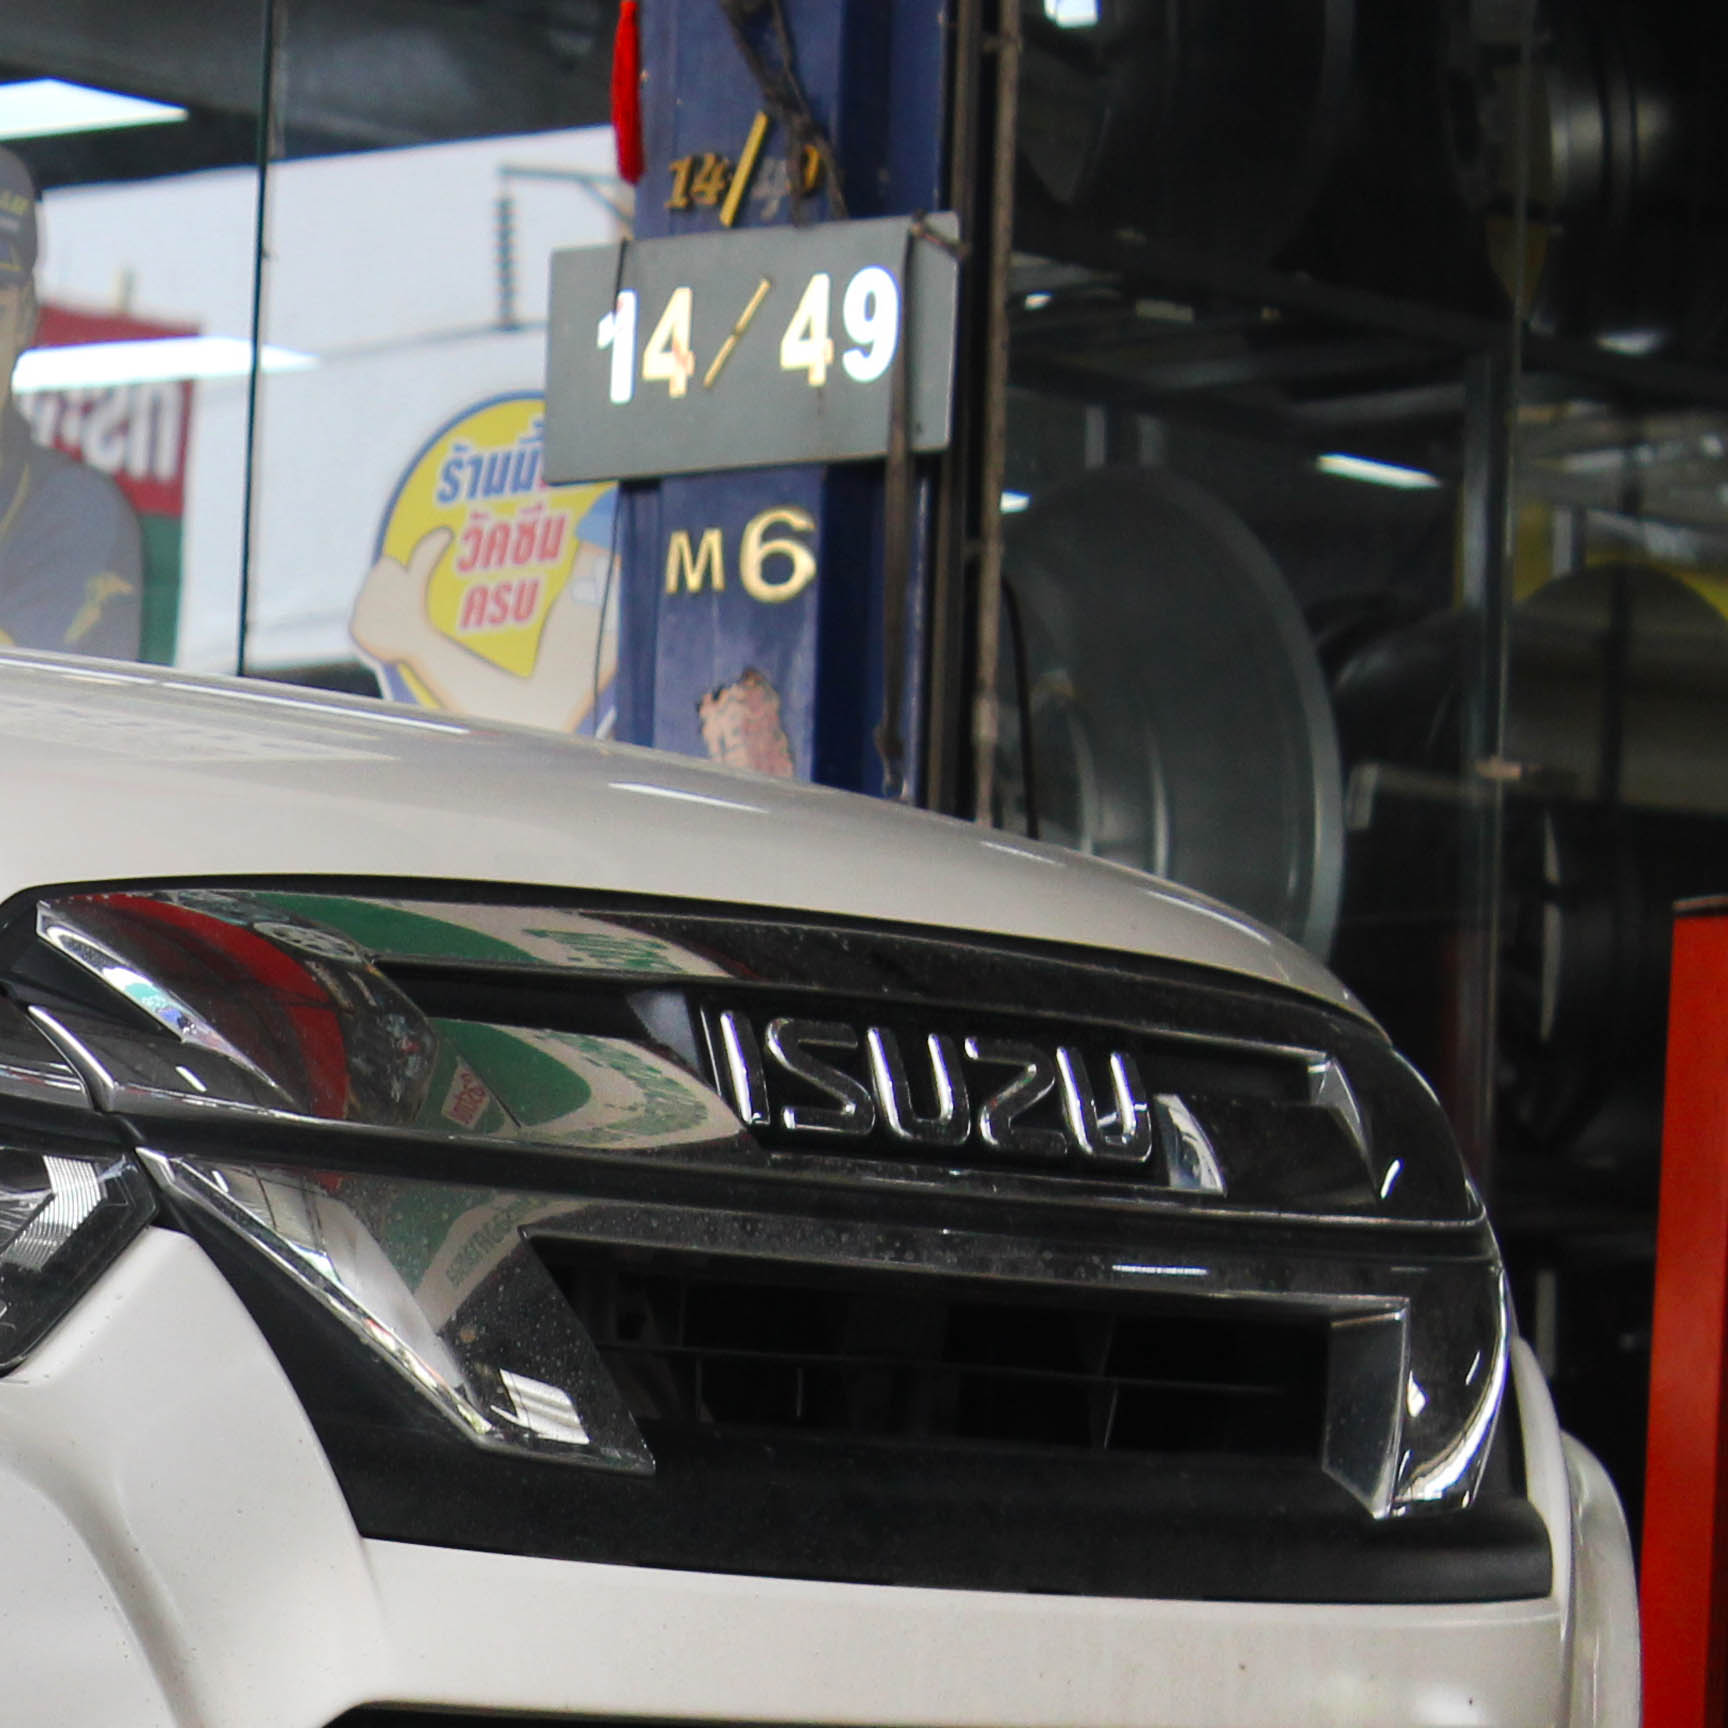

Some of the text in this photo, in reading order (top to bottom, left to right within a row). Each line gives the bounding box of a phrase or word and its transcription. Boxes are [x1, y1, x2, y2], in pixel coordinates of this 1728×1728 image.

[598, 265, 901, 404] 14/49
[460, 578, 539, 630] ครบ
[718, 1009, 1152, 1164] ISUZU
